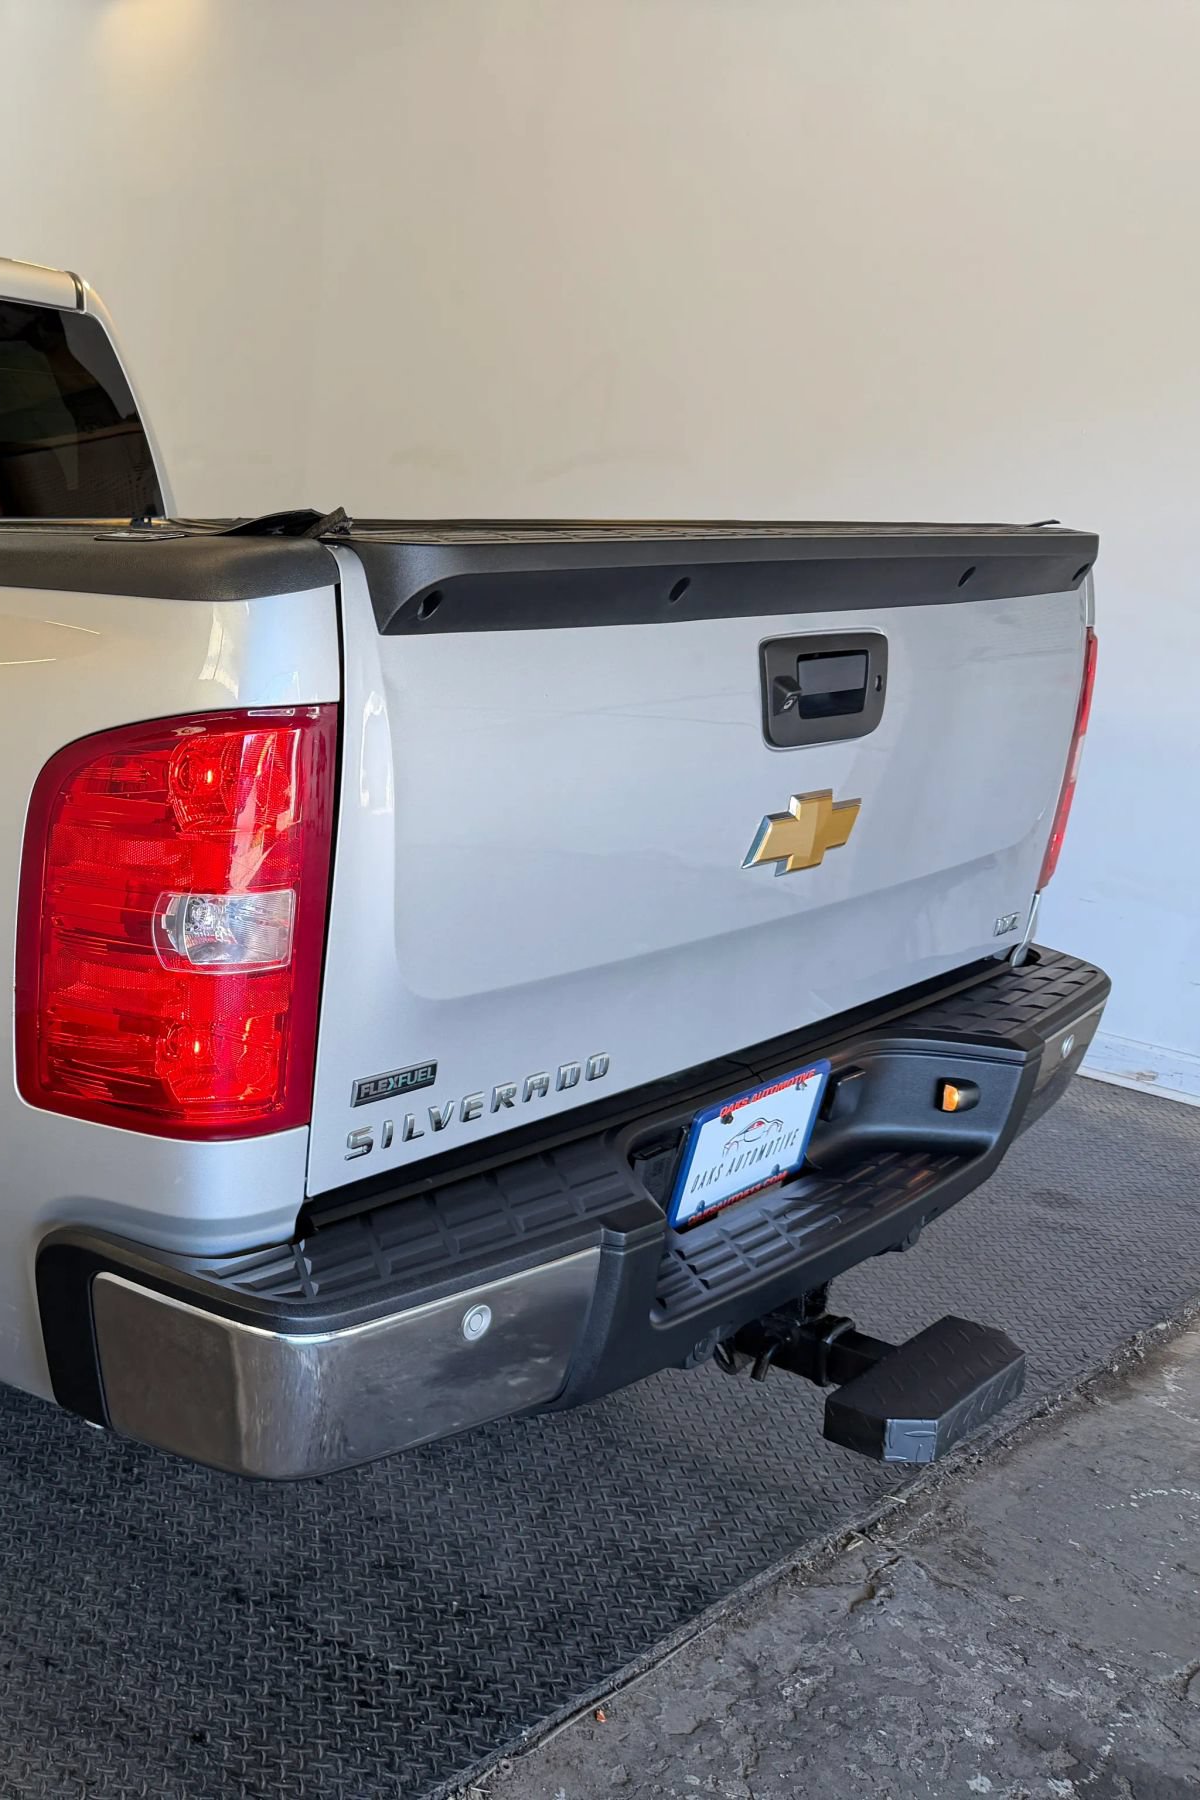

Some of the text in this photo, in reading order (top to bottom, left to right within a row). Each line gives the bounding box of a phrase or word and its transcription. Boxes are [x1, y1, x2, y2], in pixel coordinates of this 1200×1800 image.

[344, 1052, 610, 1161] SILVERADO
[360, 1066, 435, 1099] FLEXFUEL
[720, 1069, 816, 1118] OAKS AUTOMOTIVE
[690, 1128, 800, 1194] OAKS AUTOMOTIVE
